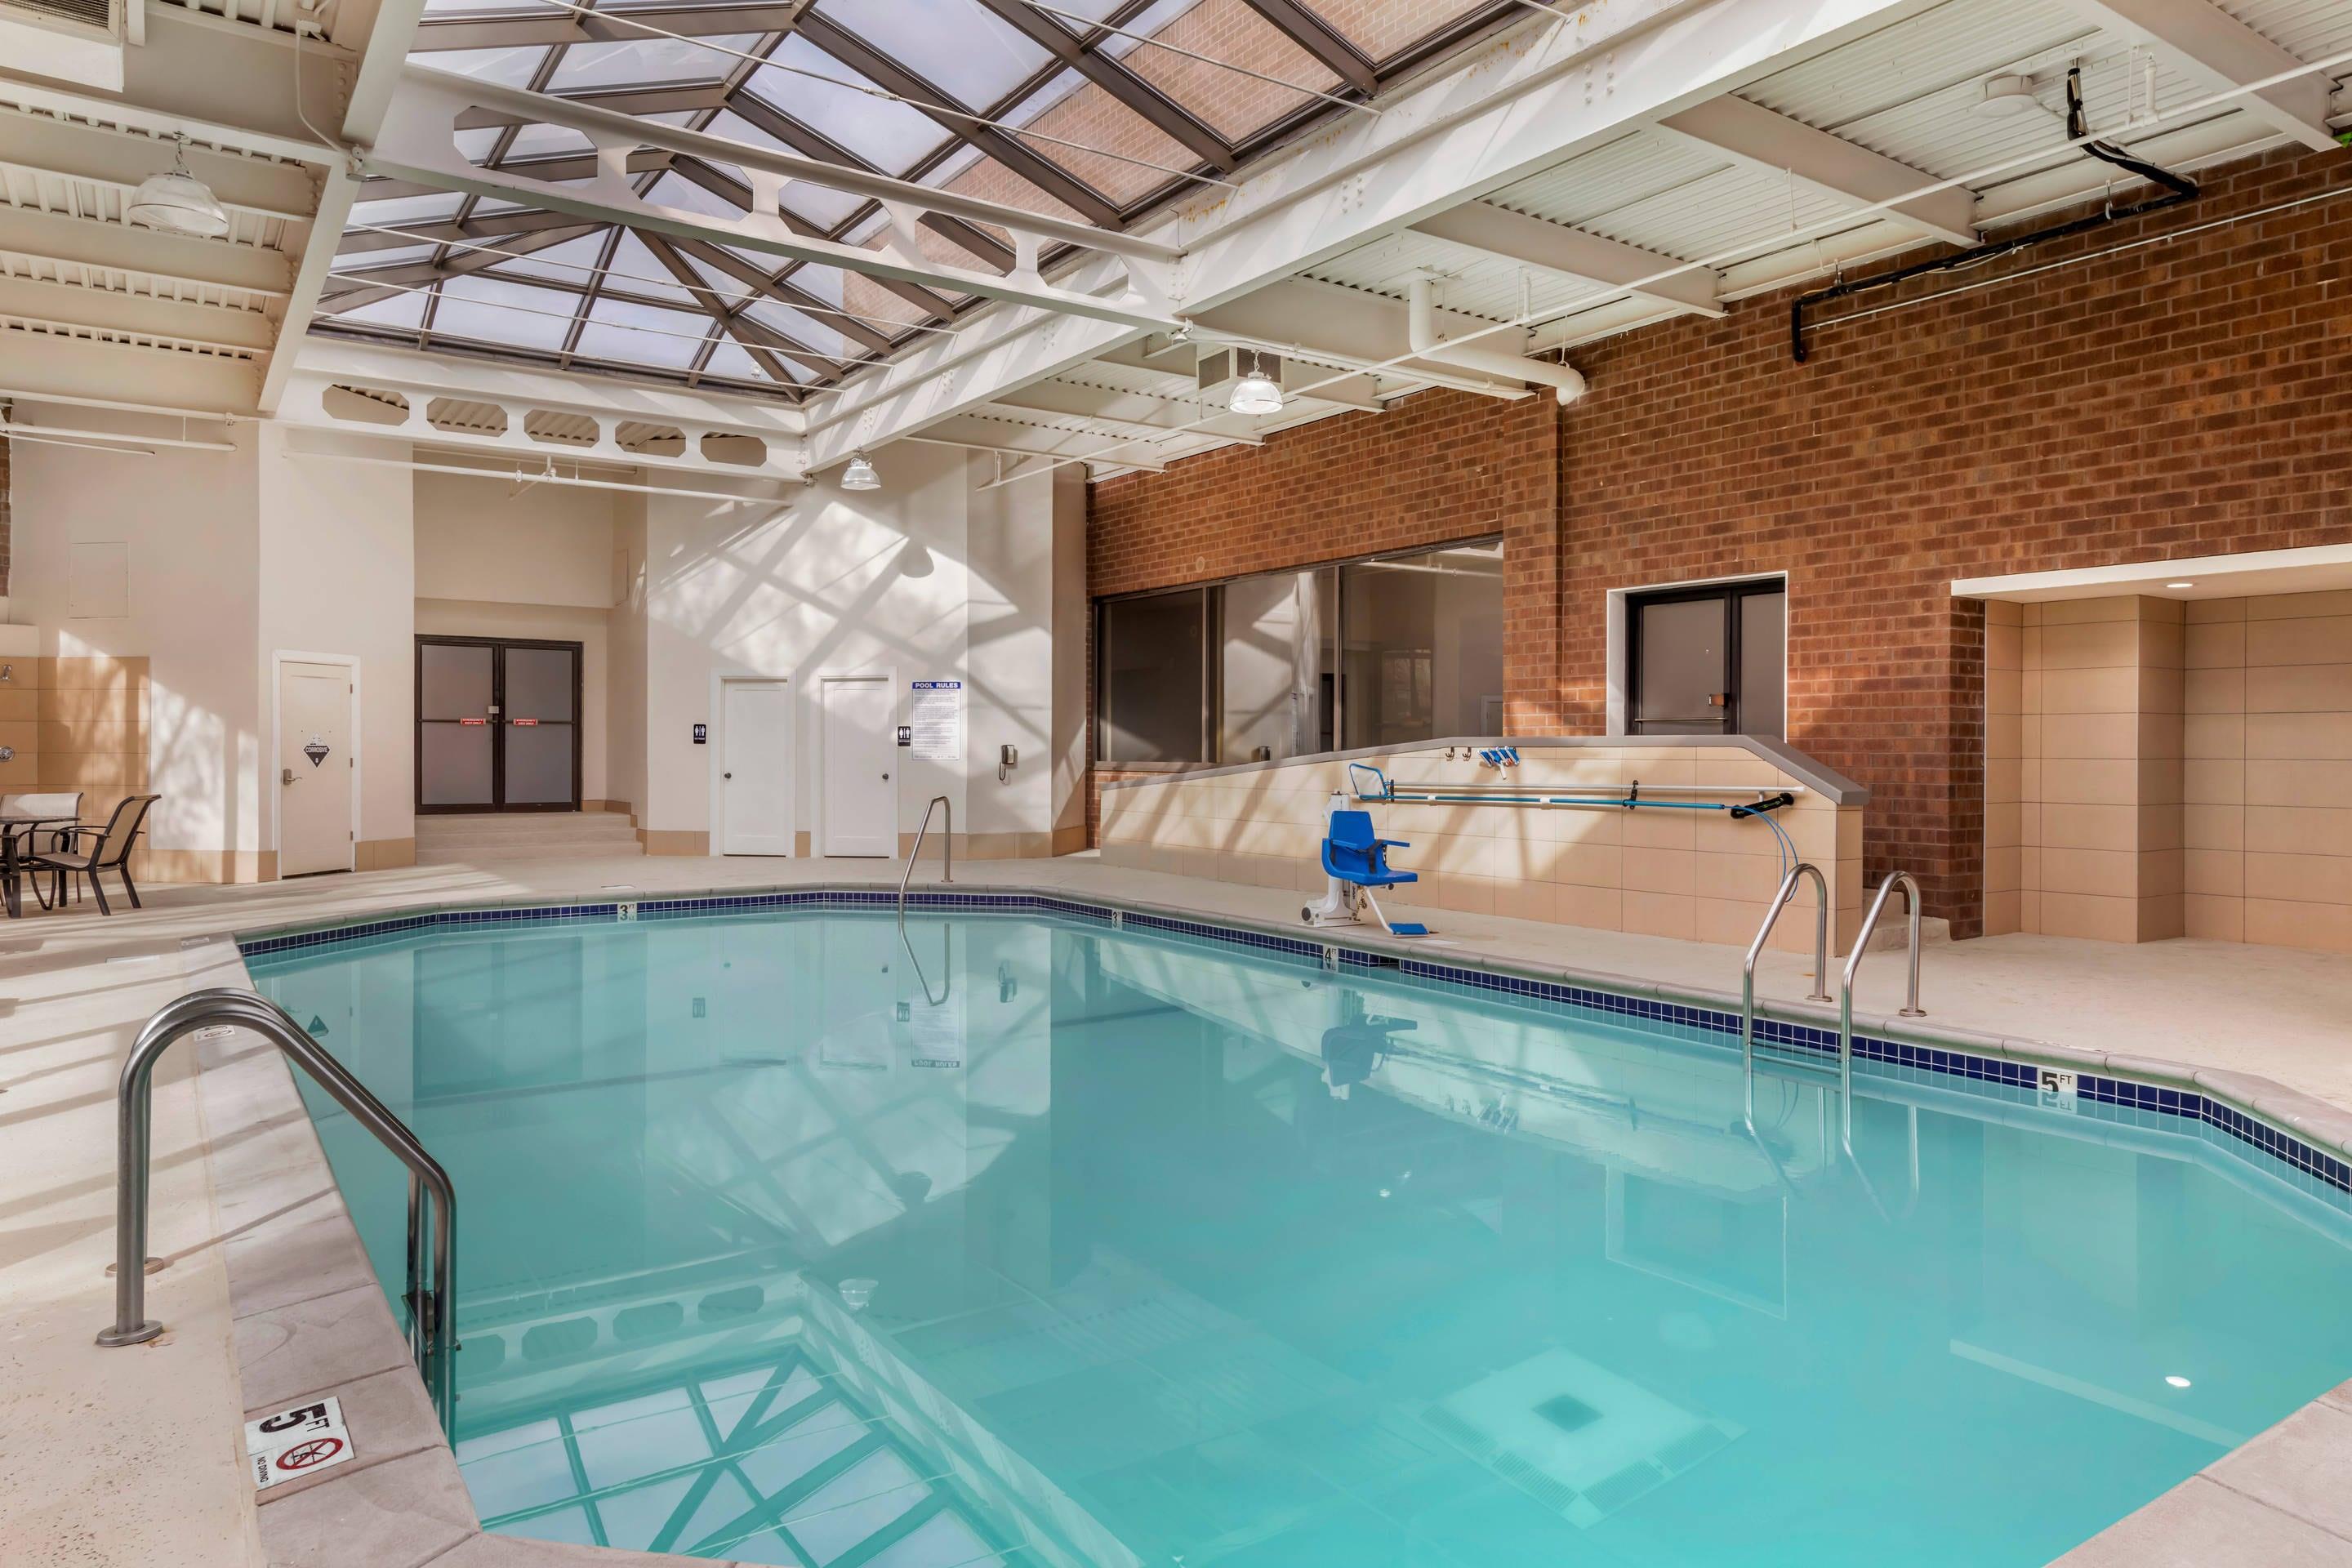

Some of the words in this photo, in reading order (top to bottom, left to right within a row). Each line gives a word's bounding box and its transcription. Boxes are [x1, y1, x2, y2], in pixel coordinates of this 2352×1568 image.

[620, 904, 628, 914] 3
[1112, 911, 1117, 921] 3
[1325, 947, 1332, 960] 4
[2042, 1071, 2059, 1092] 5
[2060, 1074, 2072, 1085] FT
[259, 1403, 327, 1433] 5
[305, 1418, 330, 1432] FT
[256, 1456, 265, 1465] NO
[258, 1464, 269, 1483] DIVING
